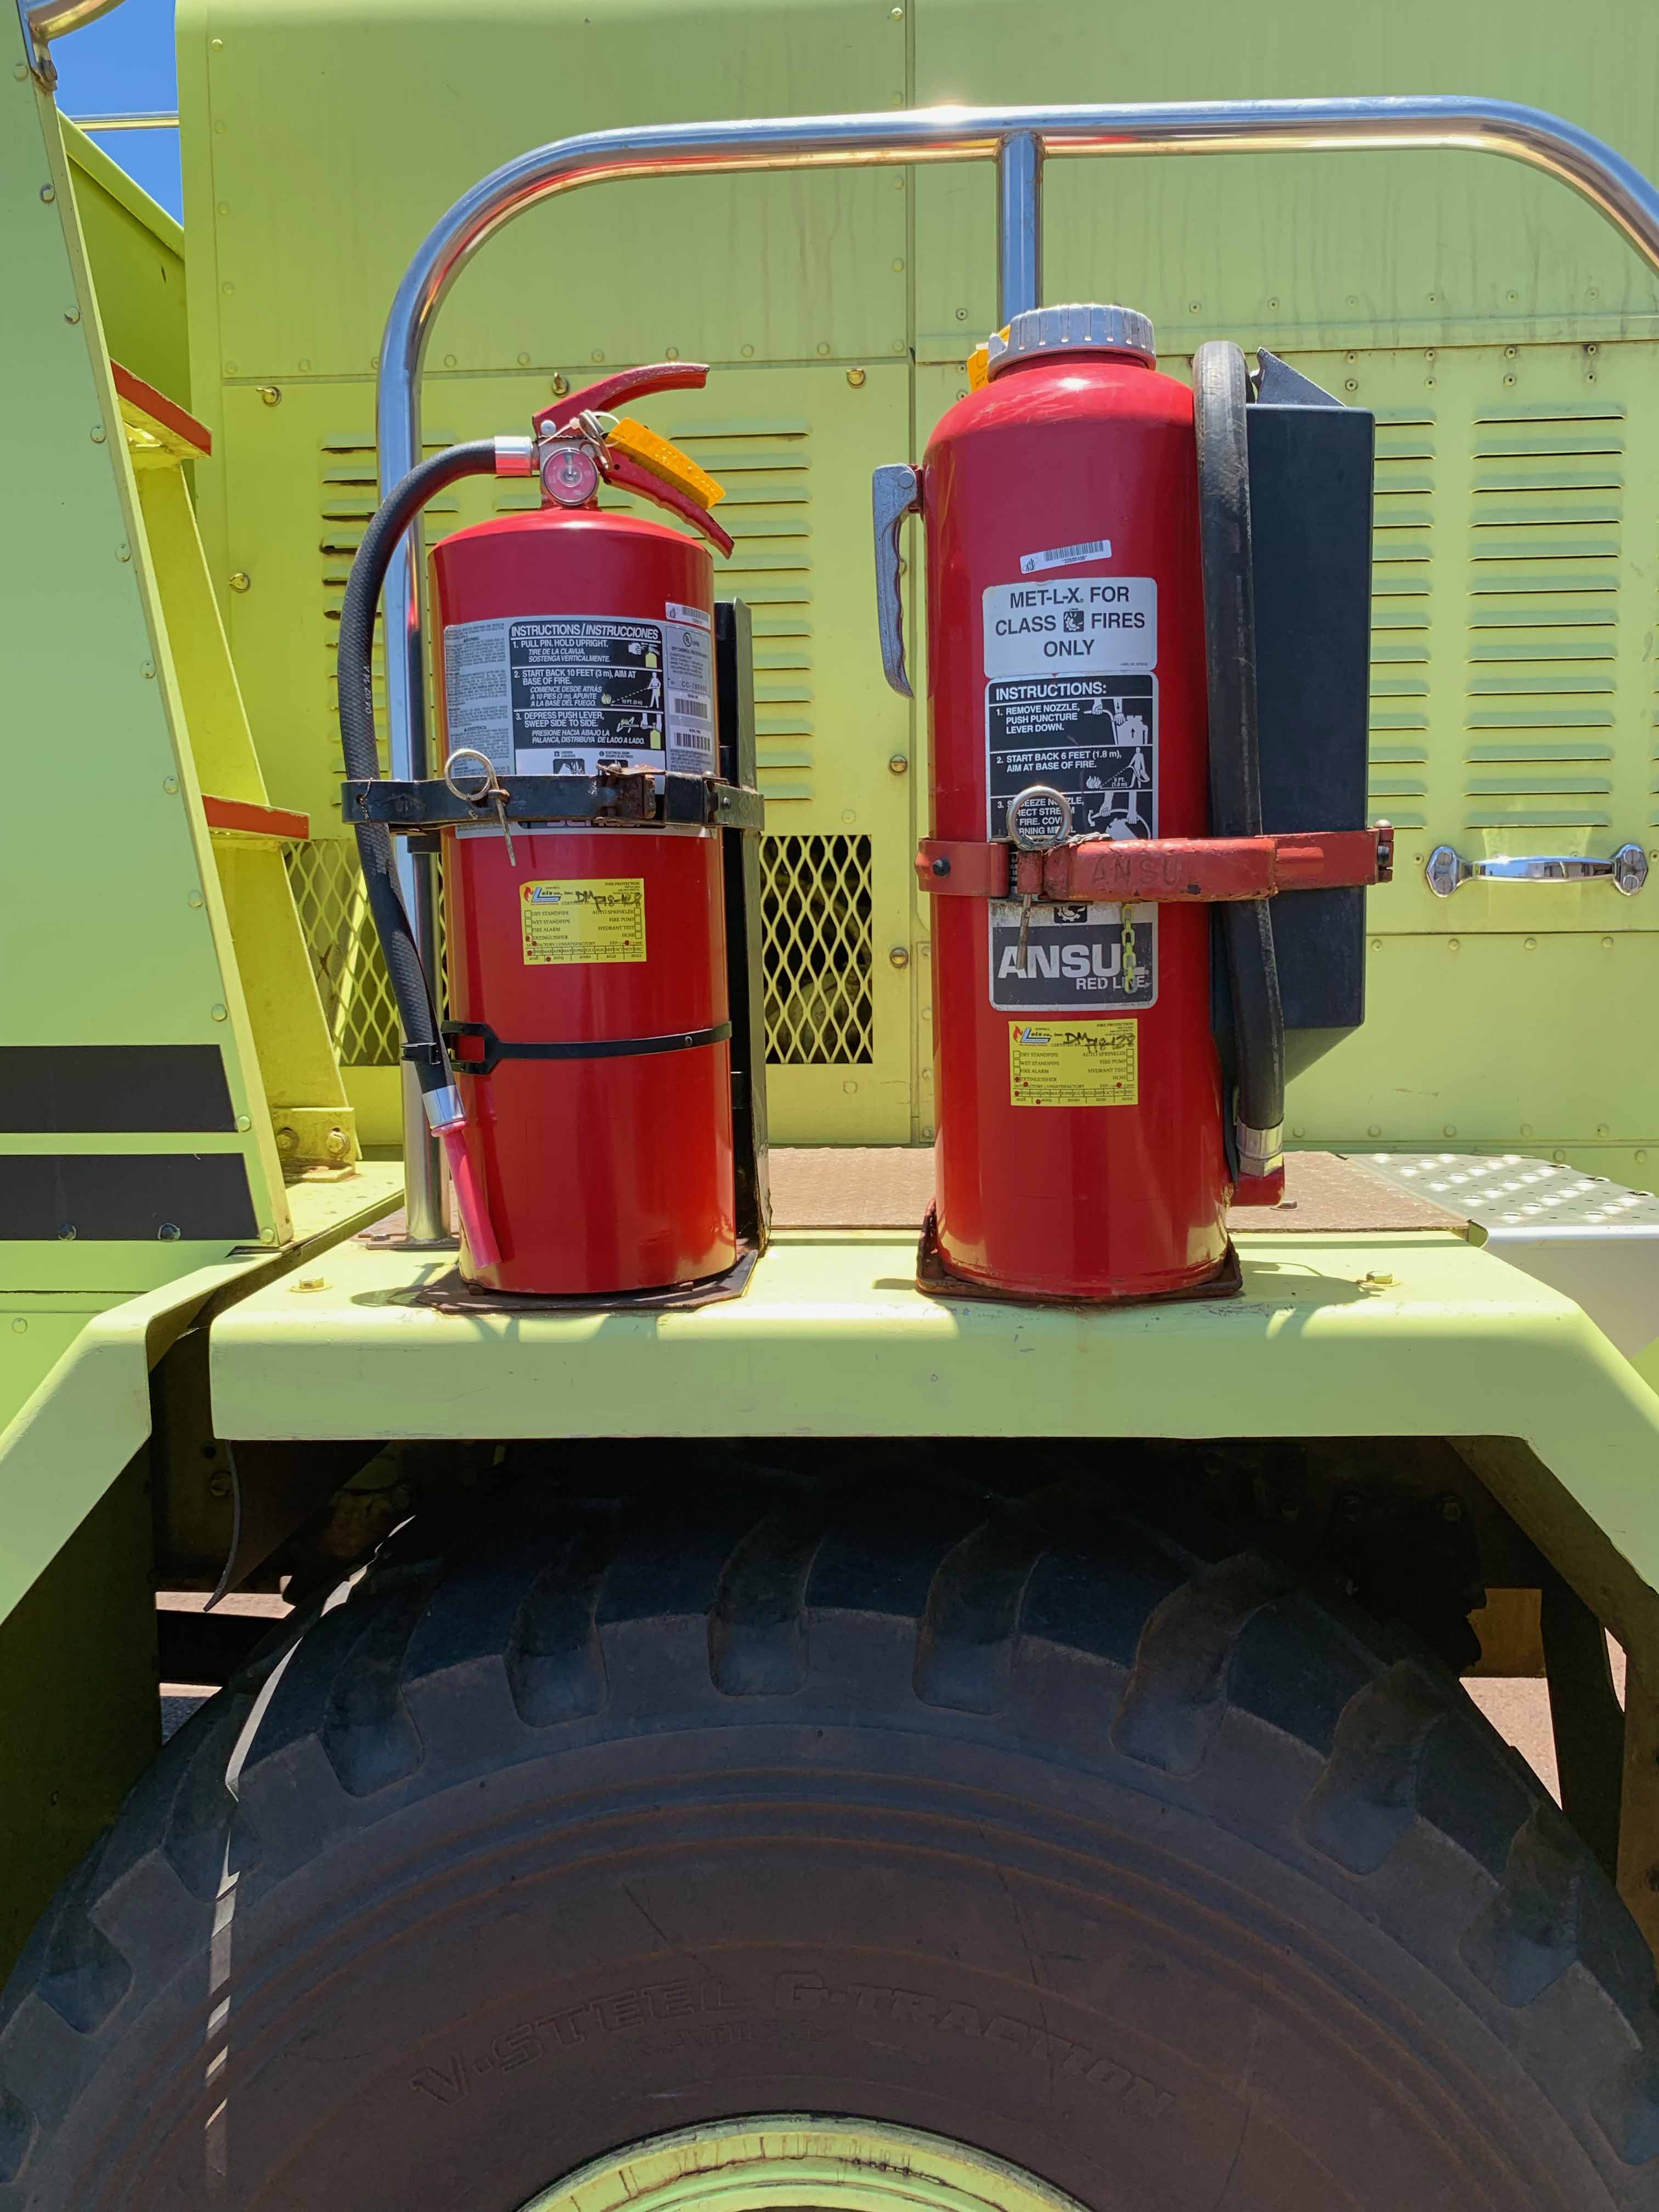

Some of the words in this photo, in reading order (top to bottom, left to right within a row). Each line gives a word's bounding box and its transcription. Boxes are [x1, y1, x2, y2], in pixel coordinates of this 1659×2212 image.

[1091, 586, 1130, 603] FOR
[995, 615, 1056, 636] CLASS
[1091, 612, 1145, 629] FIRES
[576, 639, 608, 648] UPRIGHT.
[1043, 639, 1095, 657] ONLY
[522, 670, 544, 678] START
[996, 682, 1107, 701] INSTRUCTIONS:
[1006, 706, 1041, 715] REMOVE
[1043, 703, 1080, 712] NOZZLE,
[579, 712, 604, 720] LEVER,
[1006, 716, 1029, 725] PUSH
[1031, 713, 1077, 723] PUNCTURE
[524, 720, 549, 728] SWEEP
[1006, 725, 1034, 734] LEVER
[1035, 723, 1064, 732] DOWN.
[1007, 754, 1033, 763] START
[1035, 753, 1059, 761] BACK
[1061, 752, 1066, 760] 6
[1069, 751, 1091, 759] FEET
[1007, 764, 1021, 772] AIM
[1036, 762, 1059, 771] BASE
[1075, 760, 1097, 769] FIRE.
[1007, 798, 1045, 808] SUEEZE
[1048, 797, 1085, 806] NZLE,
[1039, 806, 1075, 816] STREM
[1042, 817, 1062, 825] COV
[1047, 826, 1076, 834] MEL
[1091, 853, 1188, 886] ANSU
[1076, 978, 1108, 990] RED
[1113, 975, 1146, 989] LIE
